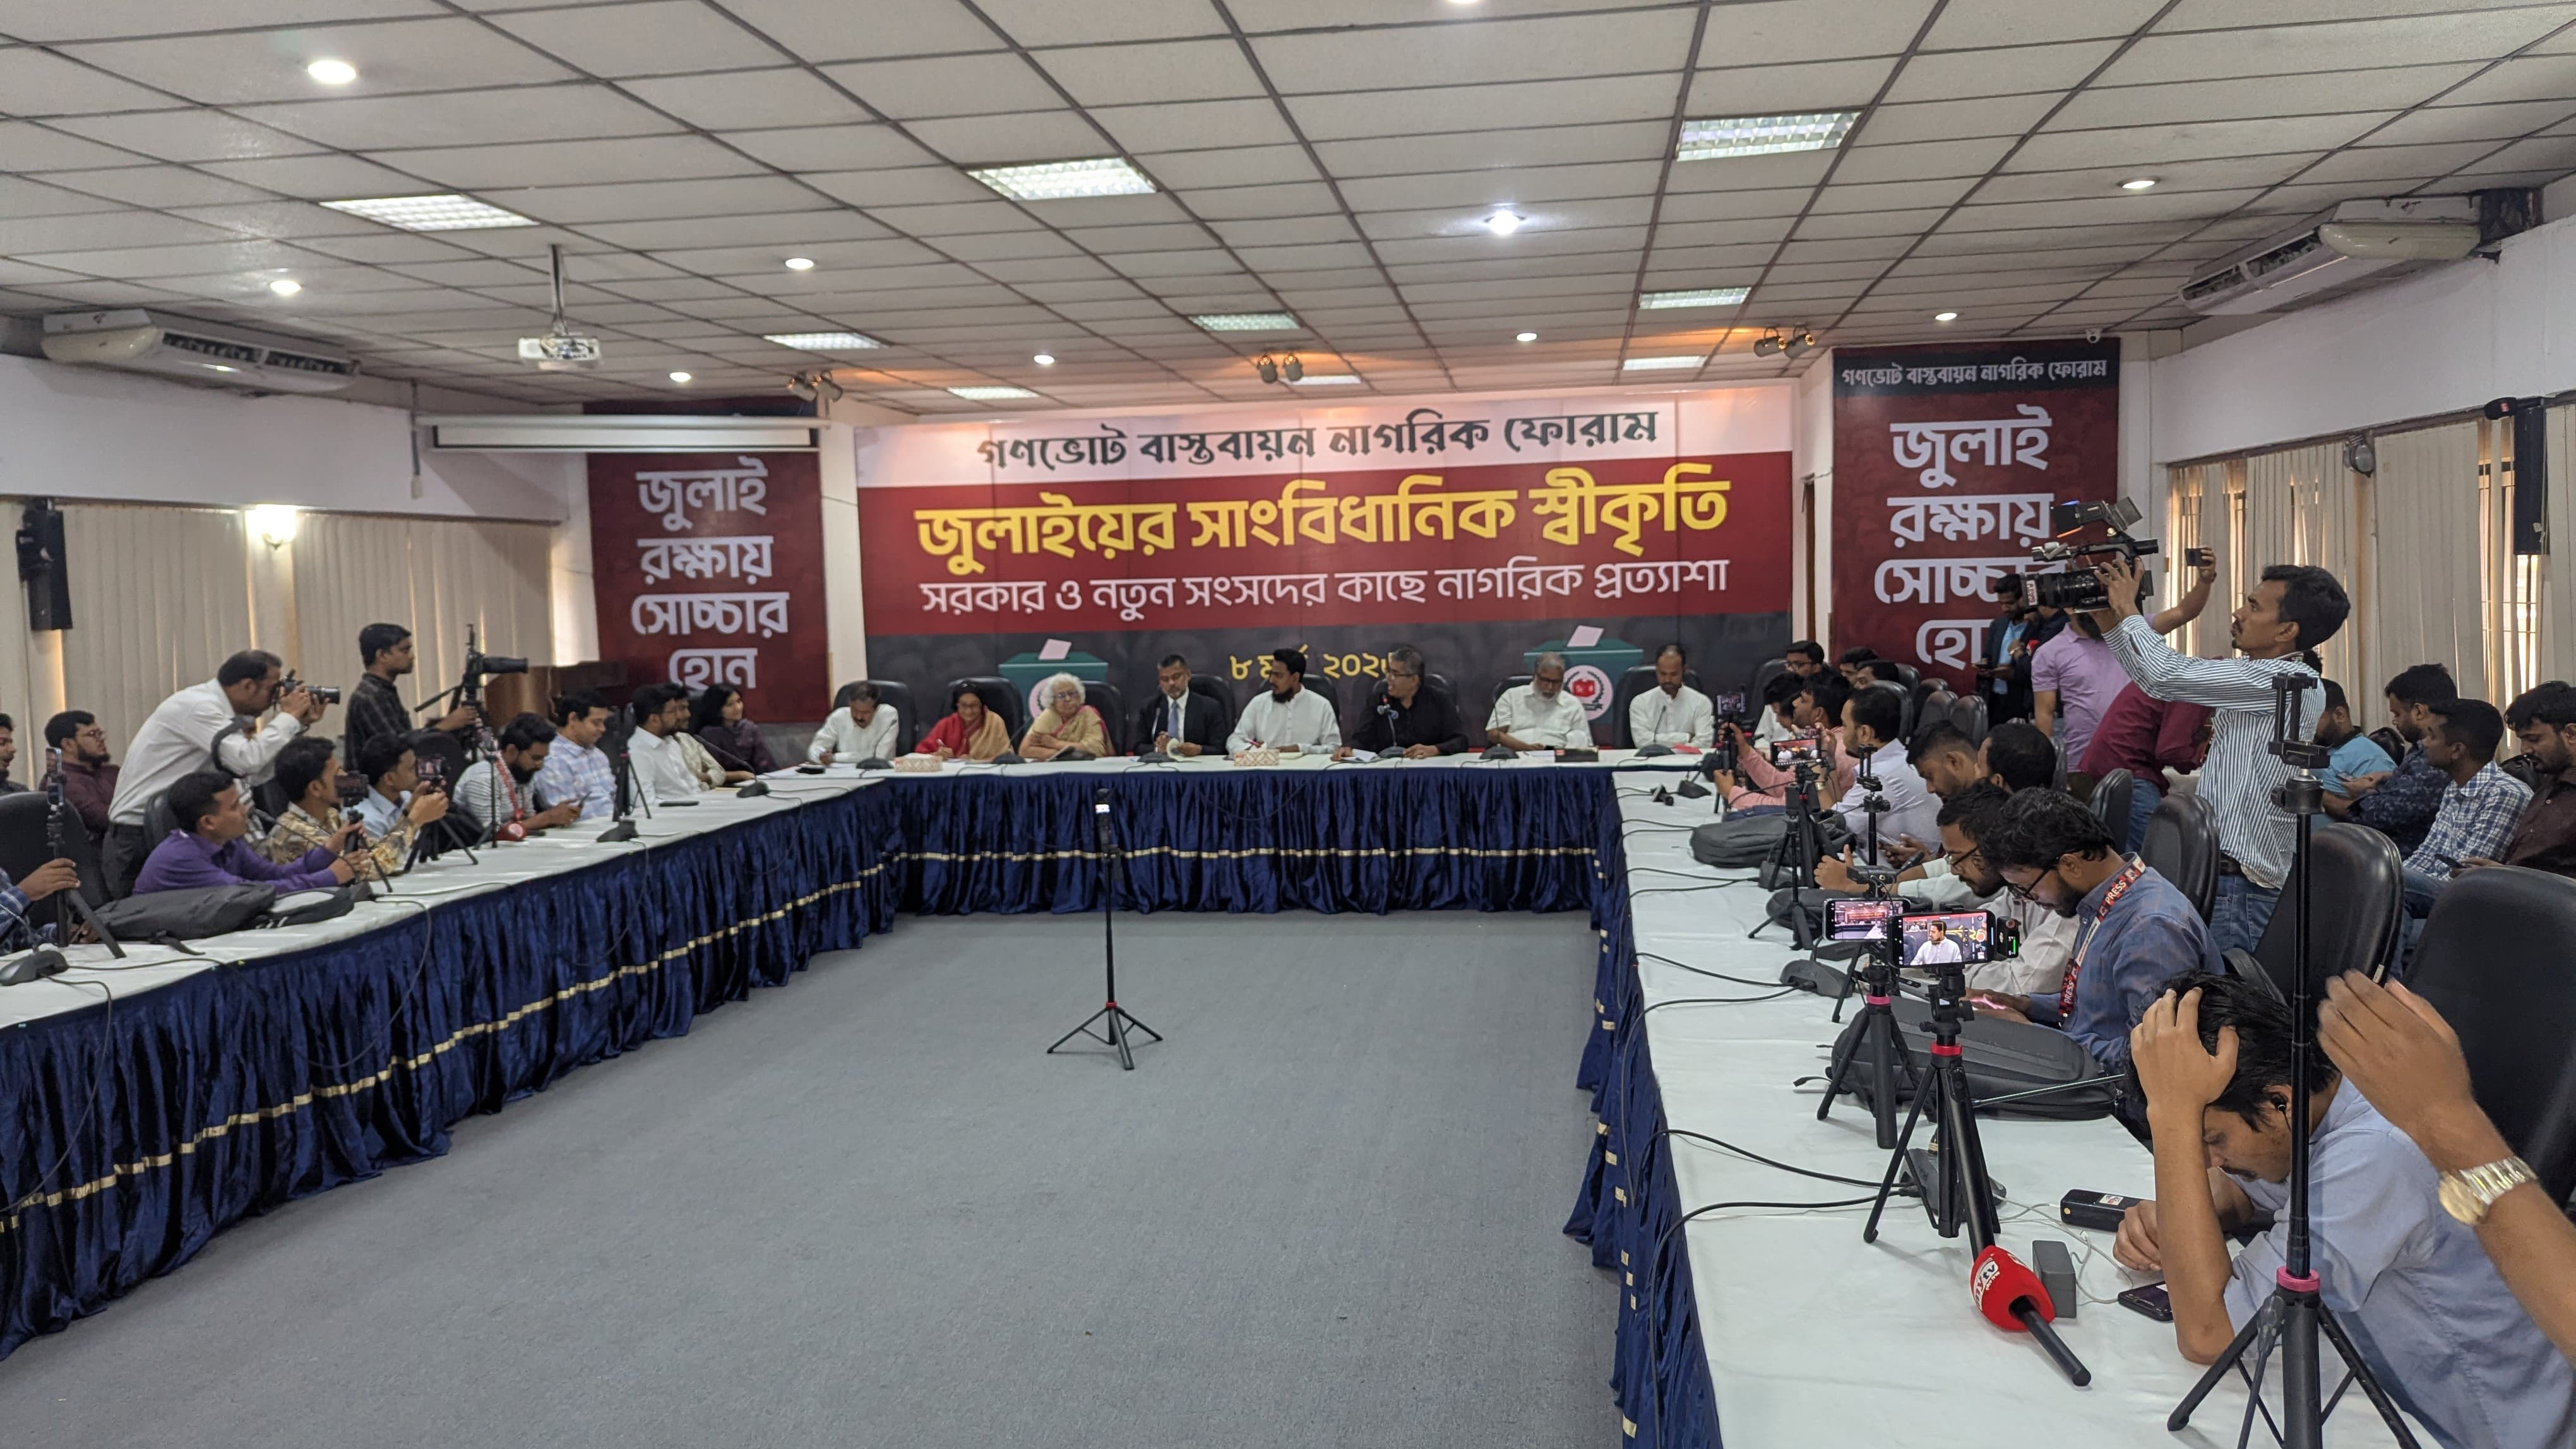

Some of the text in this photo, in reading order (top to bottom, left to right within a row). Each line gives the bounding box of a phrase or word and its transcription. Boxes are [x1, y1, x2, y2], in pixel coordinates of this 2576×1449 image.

[1841, 355, 2107, 387] গণভোট বাস্তবায়ন নাগরিক ফোরাম
[977, 408, 1659, 471] গণভোট বাস্তবায়ন নাগরিক ফোরাম
[1890, 403, 2053, 489] জুলাই
[635, 456, 768, 531] জুলাই
[914, 463, 1731, 576] জুলাইয়ের সাংবিধানিক স্বীকৃতি
[1887, 493, 2055, 548] রক্ষায়
[636, 535, 774, 585] রক্ষায়
[919, 555, 1730, 622] সরকার ও নতুন সংসদের কাছে নাগরিক প্রত্যাশা
[631, 592, 790, 639] সোচ্চার
[669, 647, 758, 691] হোন
[1230, 655, 1253, 680] ৮
[1323, 652, 1393, 679] ২০২
[1916, 619, 1993, 671] হো
[2104, 880, 2127, 904] PRESS
[2064, 981, 2075, 1005] PRESS
